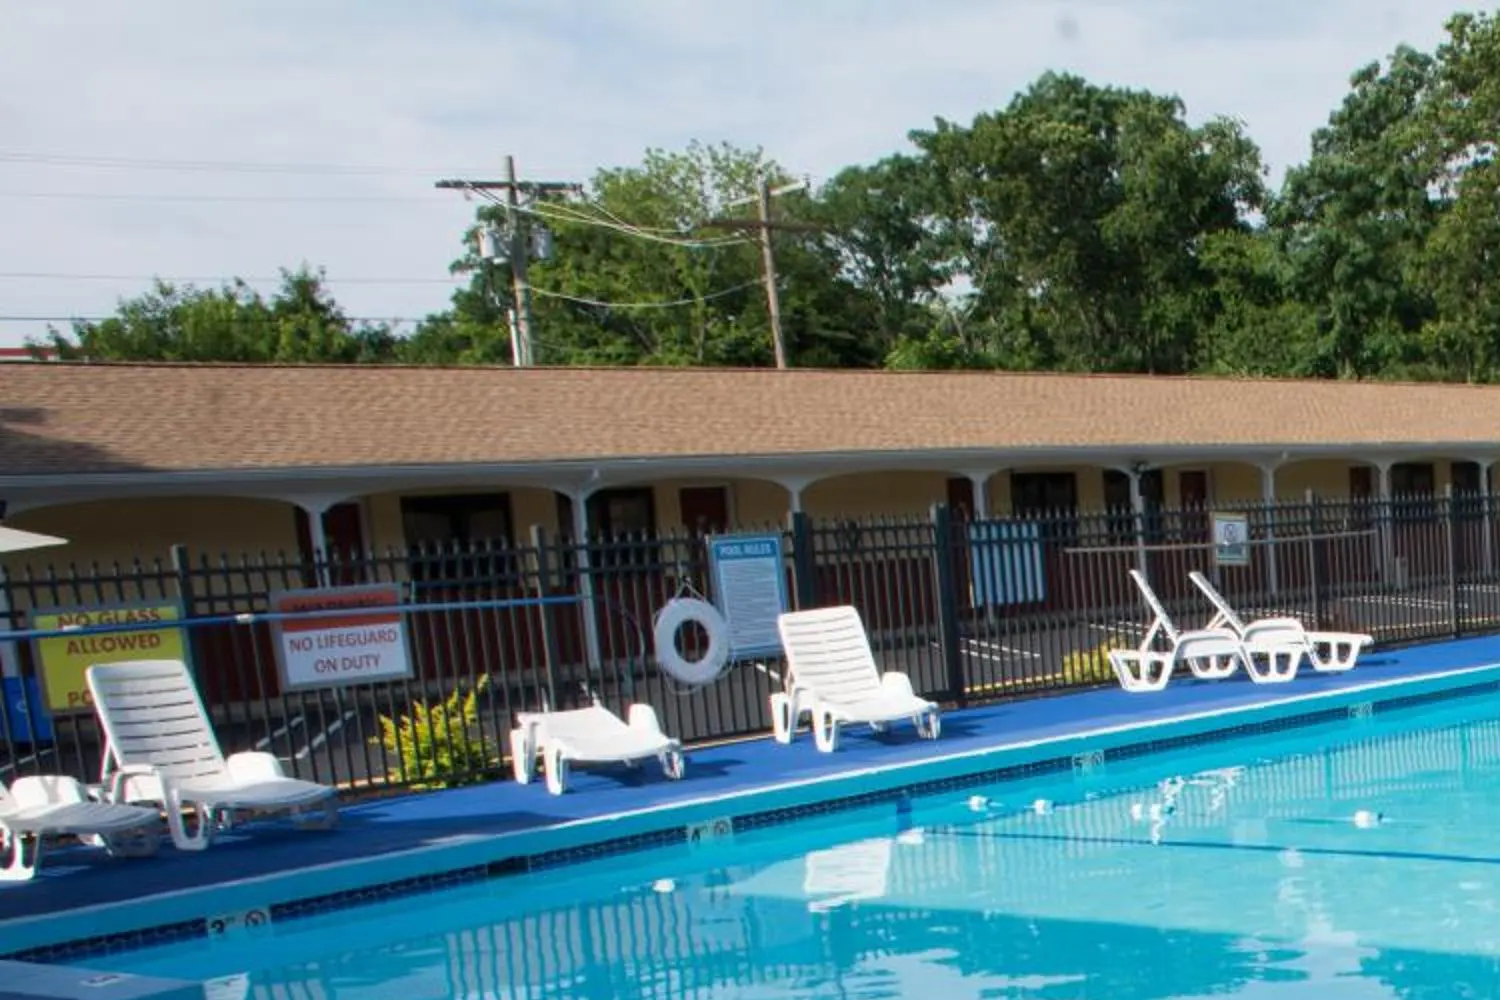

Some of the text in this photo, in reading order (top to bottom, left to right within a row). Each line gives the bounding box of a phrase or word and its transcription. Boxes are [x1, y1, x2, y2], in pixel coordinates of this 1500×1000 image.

[57, 607, 162, 628] NO GLASS
[66, 633, 162, 655] ALLOWED
[290, 628, 398, 653] NO LIFEGUARD
[313, 652, 381, 674] ON DUTY
